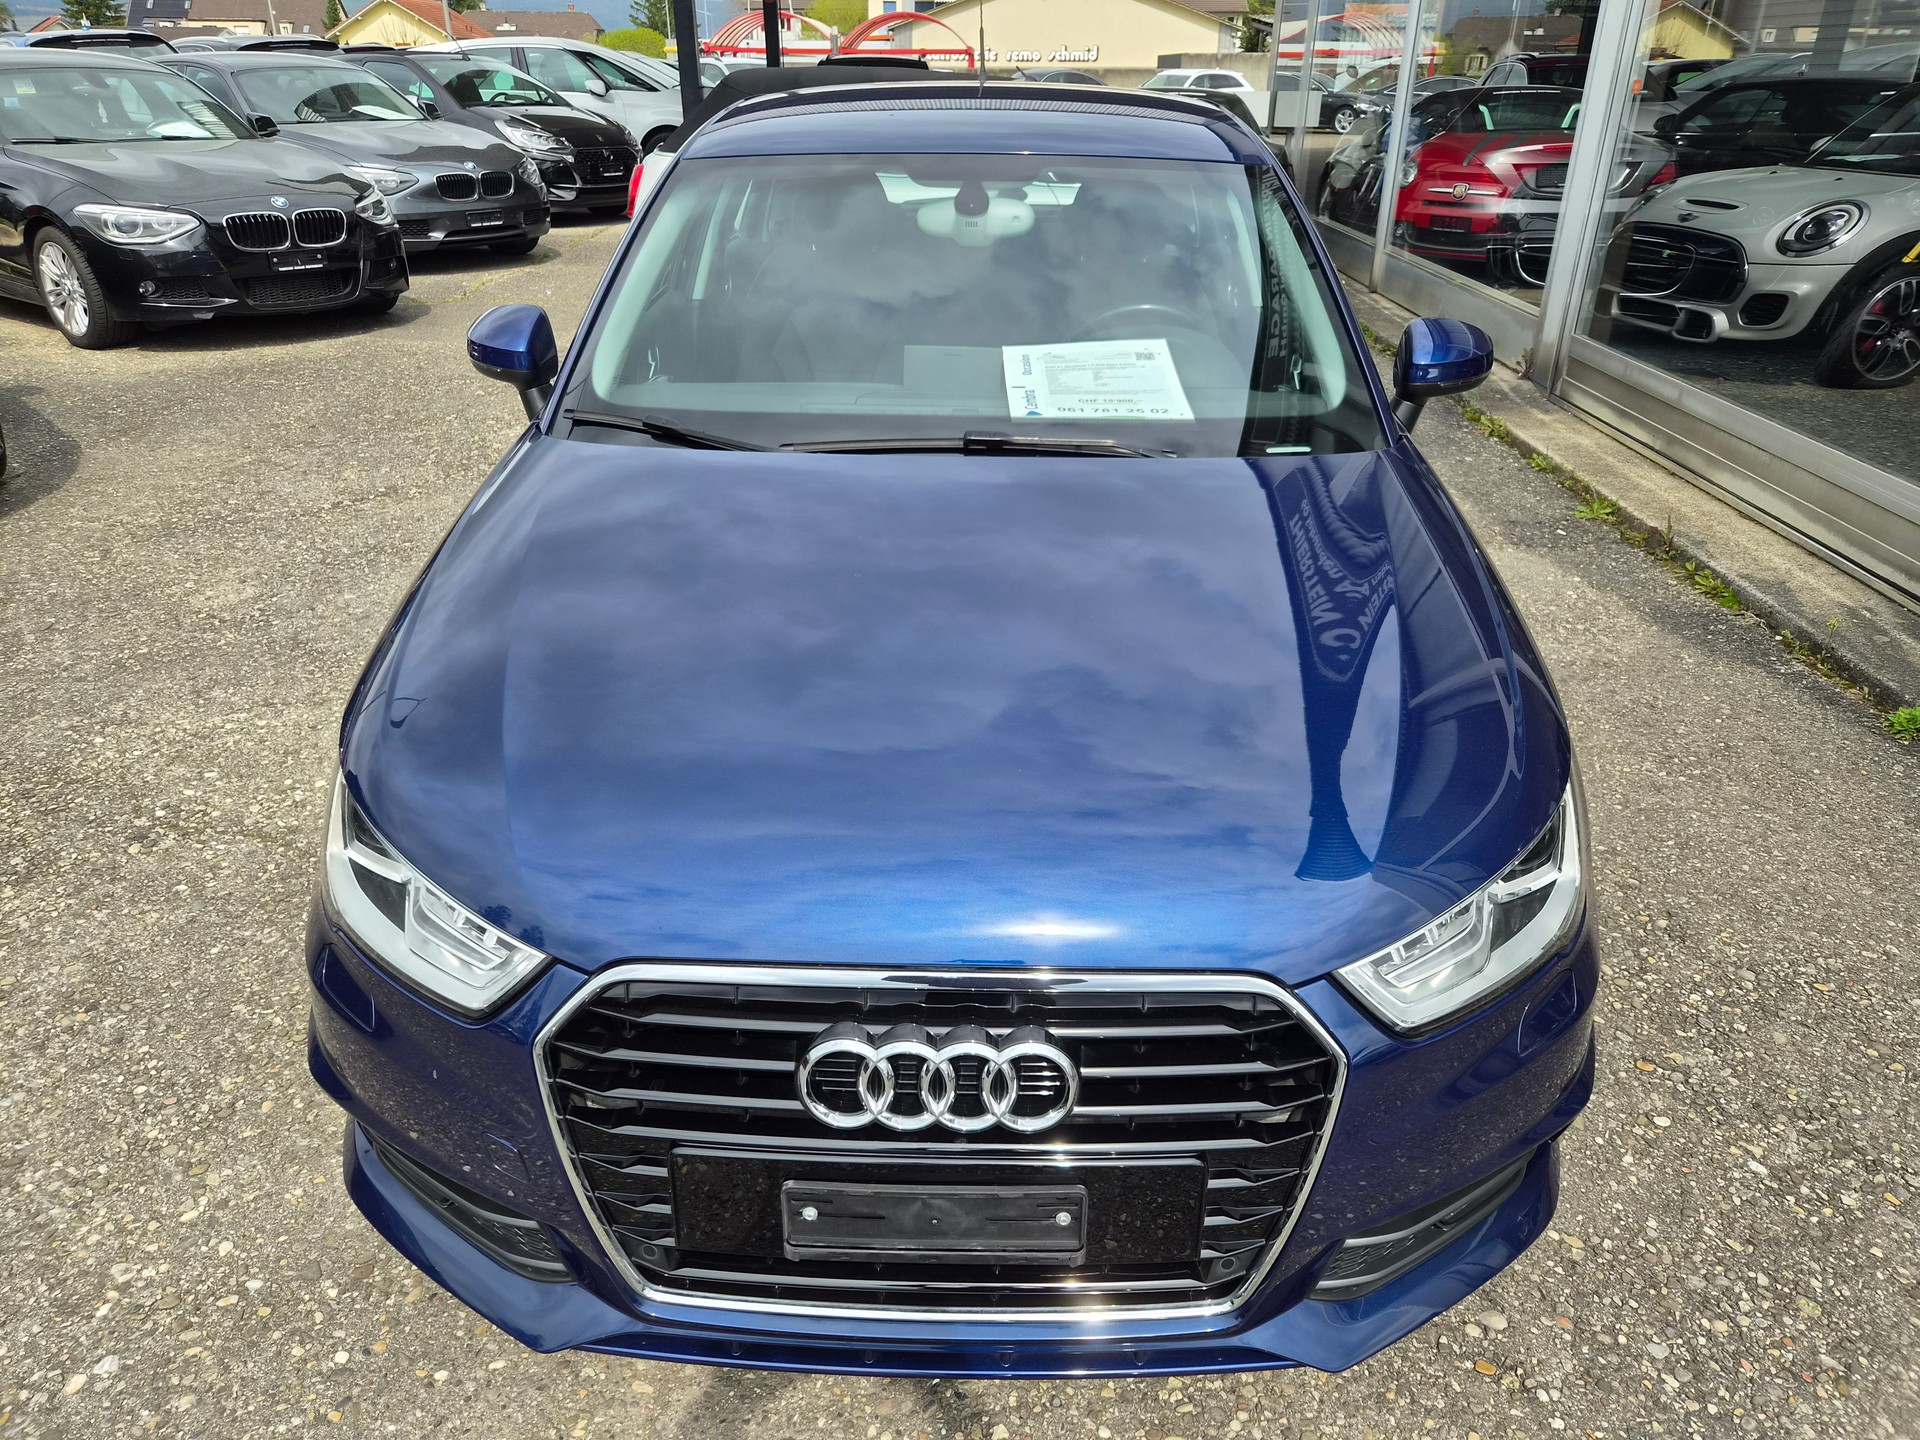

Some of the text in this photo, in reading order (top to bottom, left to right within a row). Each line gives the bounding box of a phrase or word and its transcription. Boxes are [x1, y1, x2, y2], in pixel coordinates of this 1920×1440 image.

[1006, 49, 1042, 62] remo
[1047, 44, 1099, 63] schmid
[1022, 354, 1032, 376] Occasion
